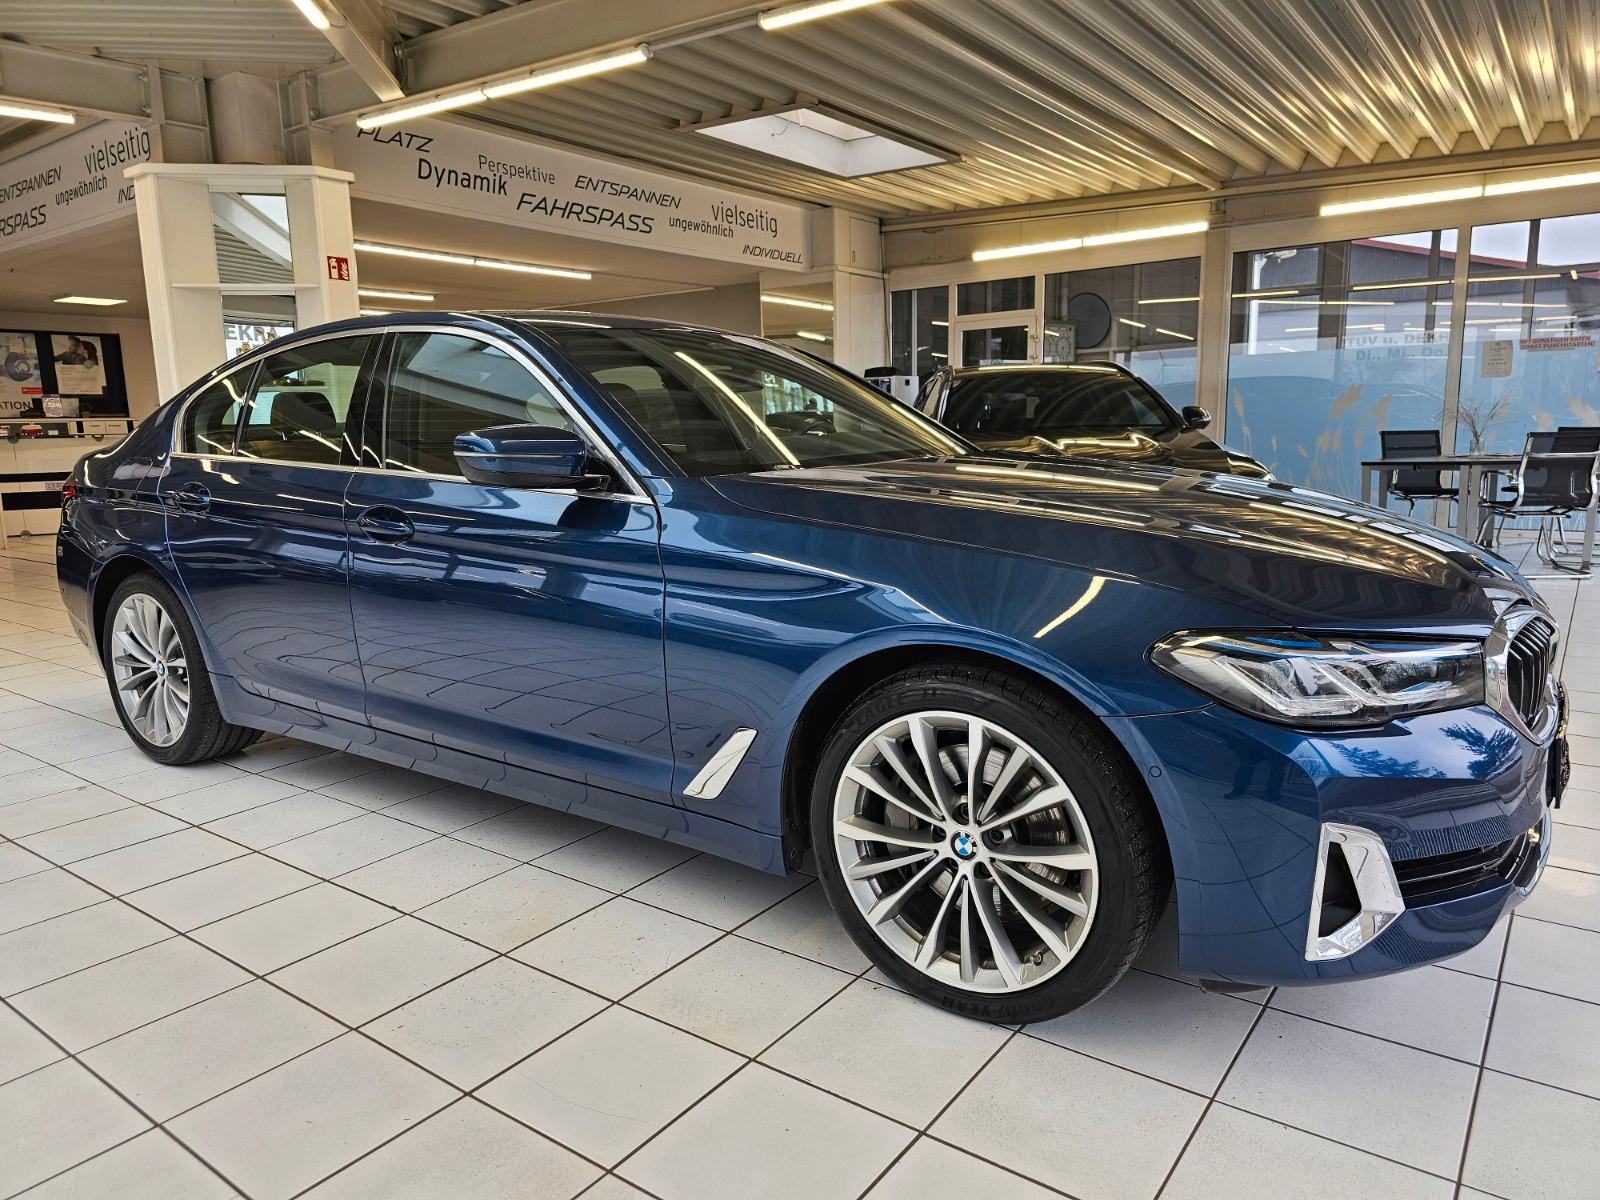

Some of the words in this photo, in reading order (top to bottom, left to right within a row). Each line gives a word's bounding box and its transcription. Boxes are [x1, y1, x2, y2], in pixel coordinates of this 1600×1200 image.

[84, 127, 151, 175] vielseitig
[356, 126, 434, 153] PLATZ
[0, 166, 62, 203] ENTSPANNEN
[417, 158, 508, 196] Dynamik
[478, 154, 556, 185] Perspektive
[55, 175, 108, 206] ungewöhnlich
[574, 175, 682, 209] ENTSPANNEN
[0, 204, 47, 236] RSPASS
[516, 192, 655, 234] FAHRSPASS
[669, 216, 735, 239] ungewöhnlich
[711, 201, 778, 238] vielseitig
[742, 244, 804, 264] INDIVIDUELL
